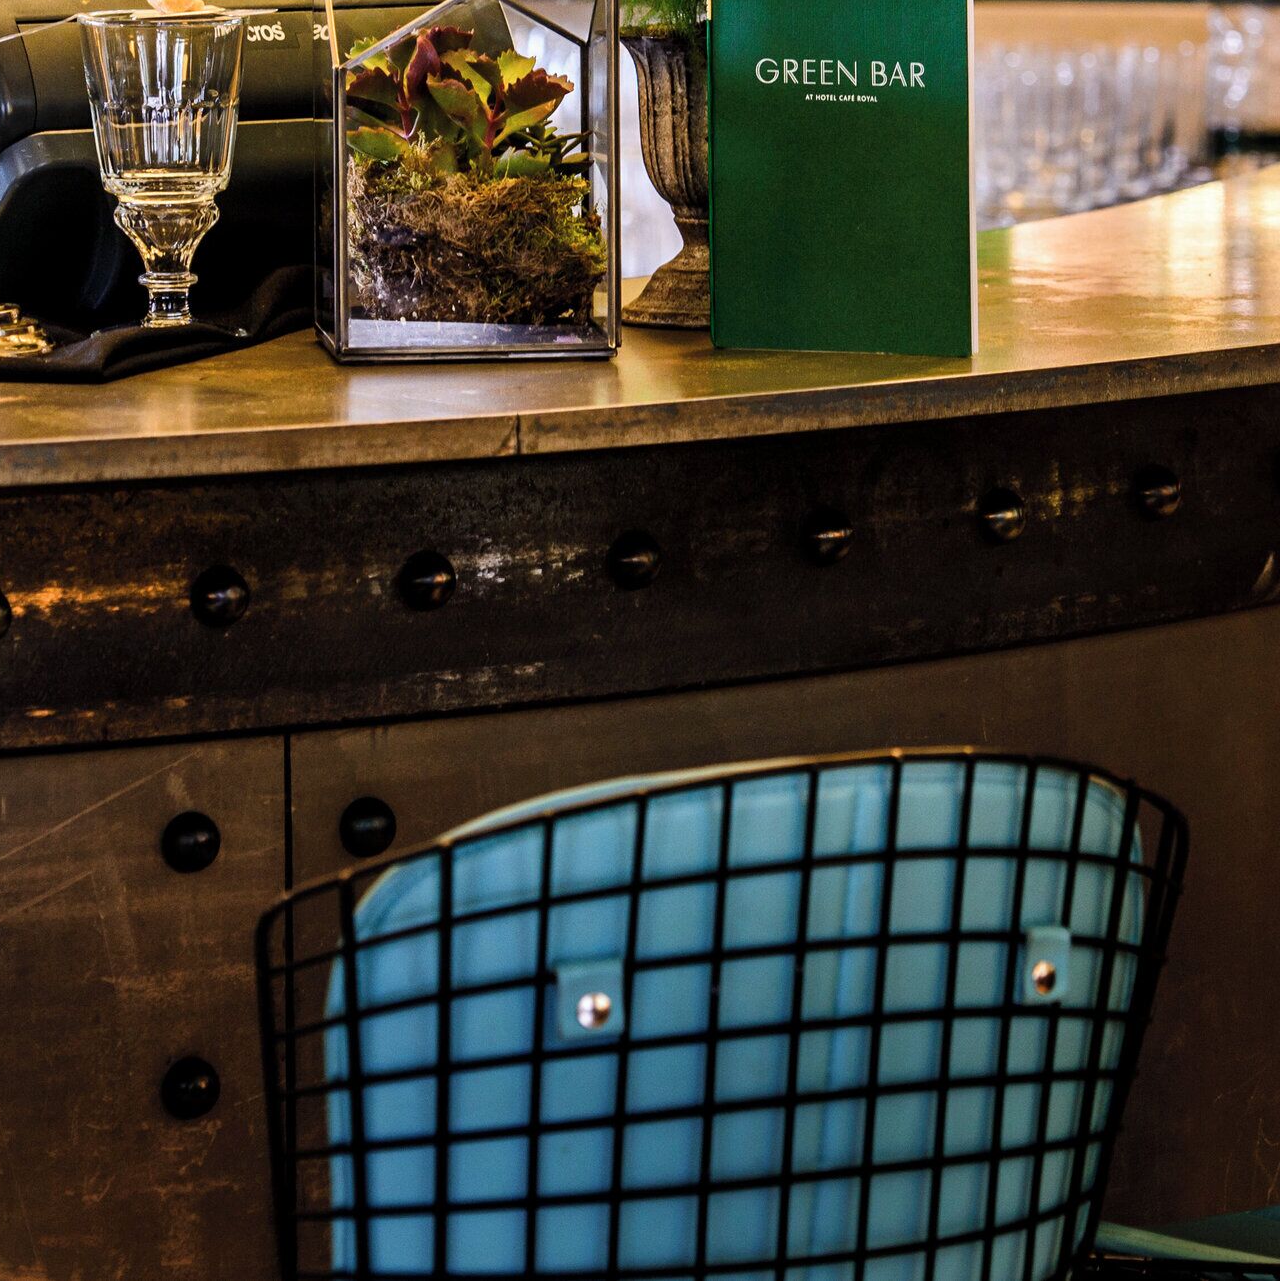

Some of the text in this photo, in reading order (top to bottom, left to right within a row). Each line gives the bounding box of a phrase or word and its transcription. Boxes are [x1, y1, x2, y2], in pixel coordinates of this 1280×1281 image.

[755, 58, 925, 88] GREEN BAR
[805, 93, 878, 103] AT HOTEL CAFÉ ROYAL
